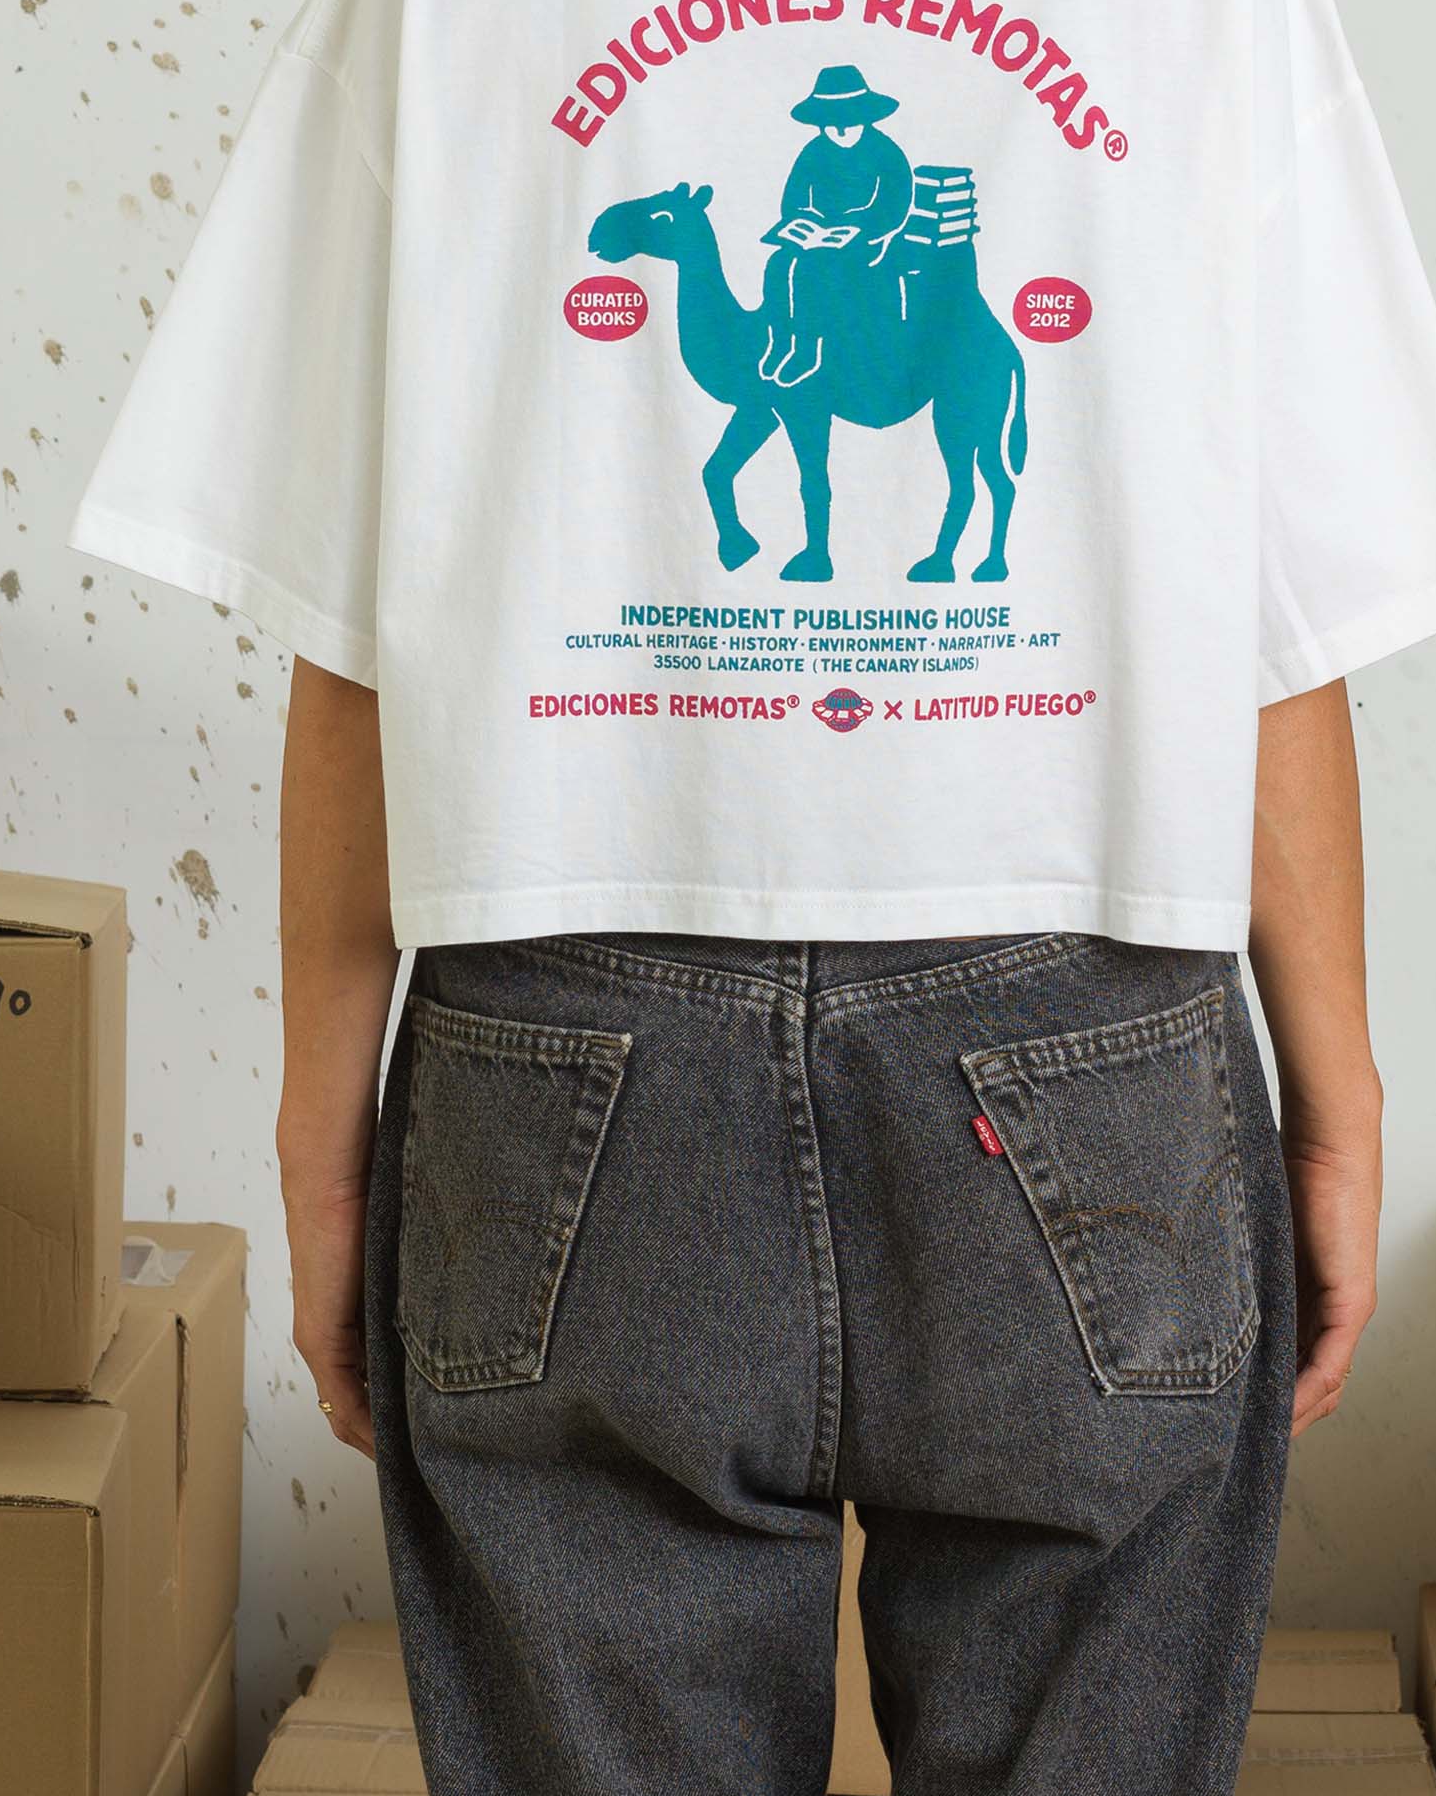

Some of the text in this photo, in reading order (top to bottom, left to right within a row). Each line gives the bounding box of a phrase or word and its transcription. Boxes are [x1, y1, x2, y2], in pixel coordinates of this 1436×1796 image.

[570, 292, 644, 308] CURATED
[1026, 293, 1076, 310] SINCE
[577, 311, 636, 326] BOOKS
[1029, 312, 1071, 328] 2012
[620, 604, 1011, 631] INDEPENDENT PUBLISHING HOUSE
[565, 632, 1061, 652] CULTURAL HERITAGE HISTORY ENVIRONMENT NARRATIVE ART
[653, 655, 701, 670] 35500
[707, 656, 804, 672] LANZAROTE
[855, 657, 919, 673] CANARY
[922, 656, 979, 672] ISLANDS)
[529, 693, 659, 718] EDICIONES
[914, 695, 999, 721] LATITUD
